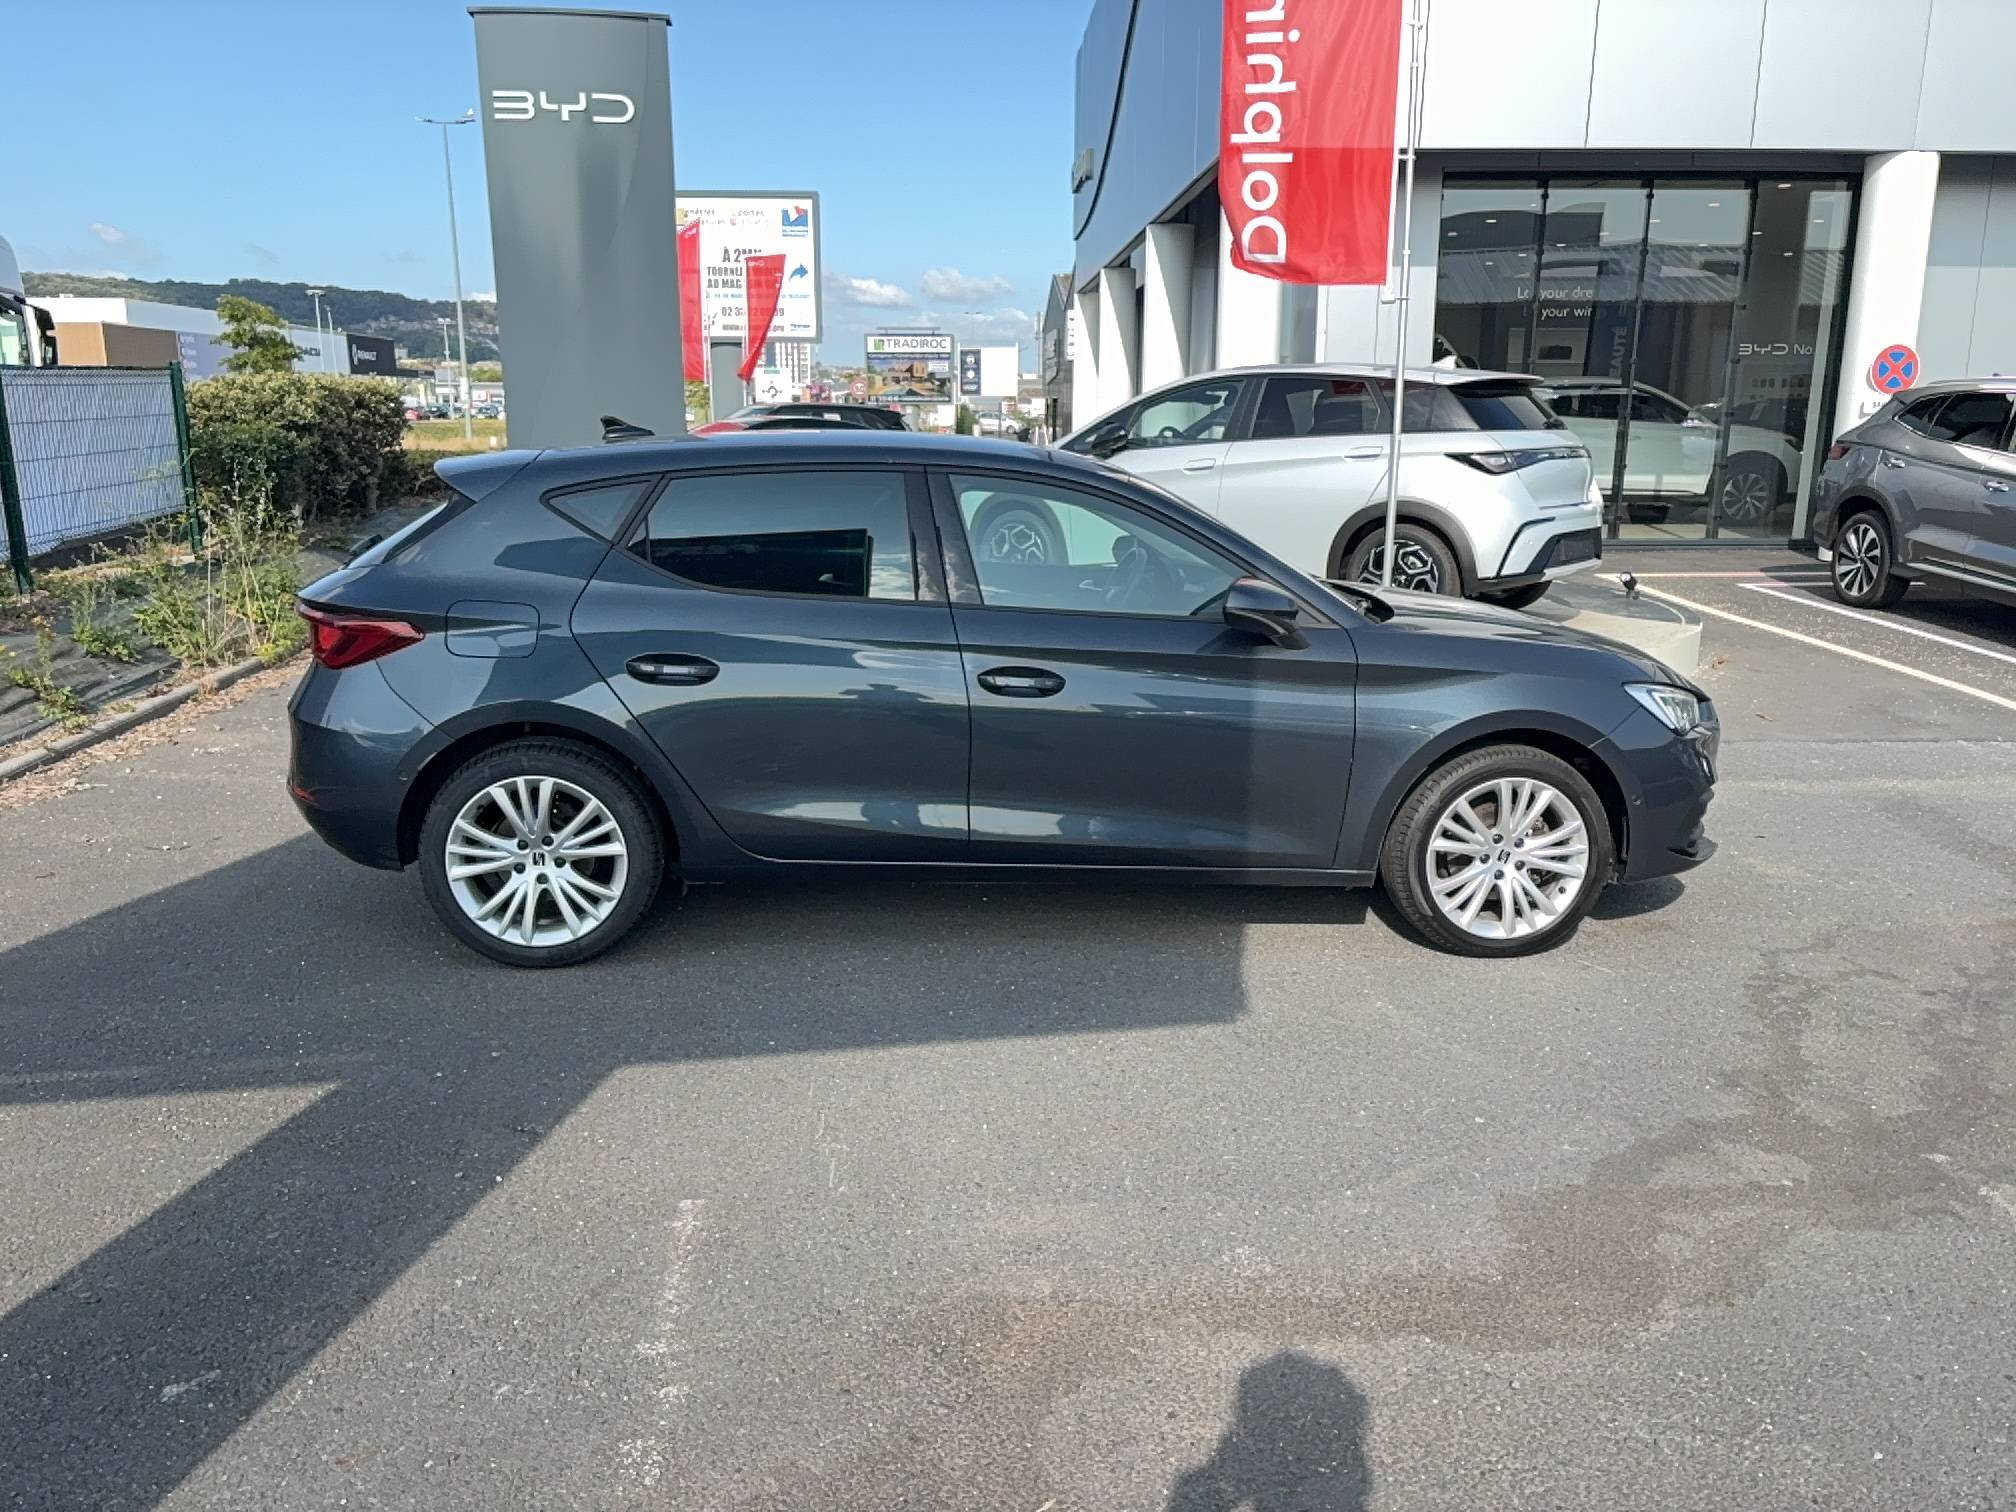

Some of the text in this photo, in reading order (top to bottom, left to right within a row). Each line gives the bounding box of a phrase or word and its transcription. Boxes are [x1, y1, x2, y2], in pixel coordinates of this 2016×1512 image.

[492, 89, 636, 124] BYD
[1540, 289, 1569, 302] your
[1572, 285, 1593, 299] dre
[1541, 308, 1570, 321] your
[886, 338, 947, 349] TRADIROC
[1738, 343, 1813, 355] BYD No
[1608, 325, 1628, 378] EAUTÉ
